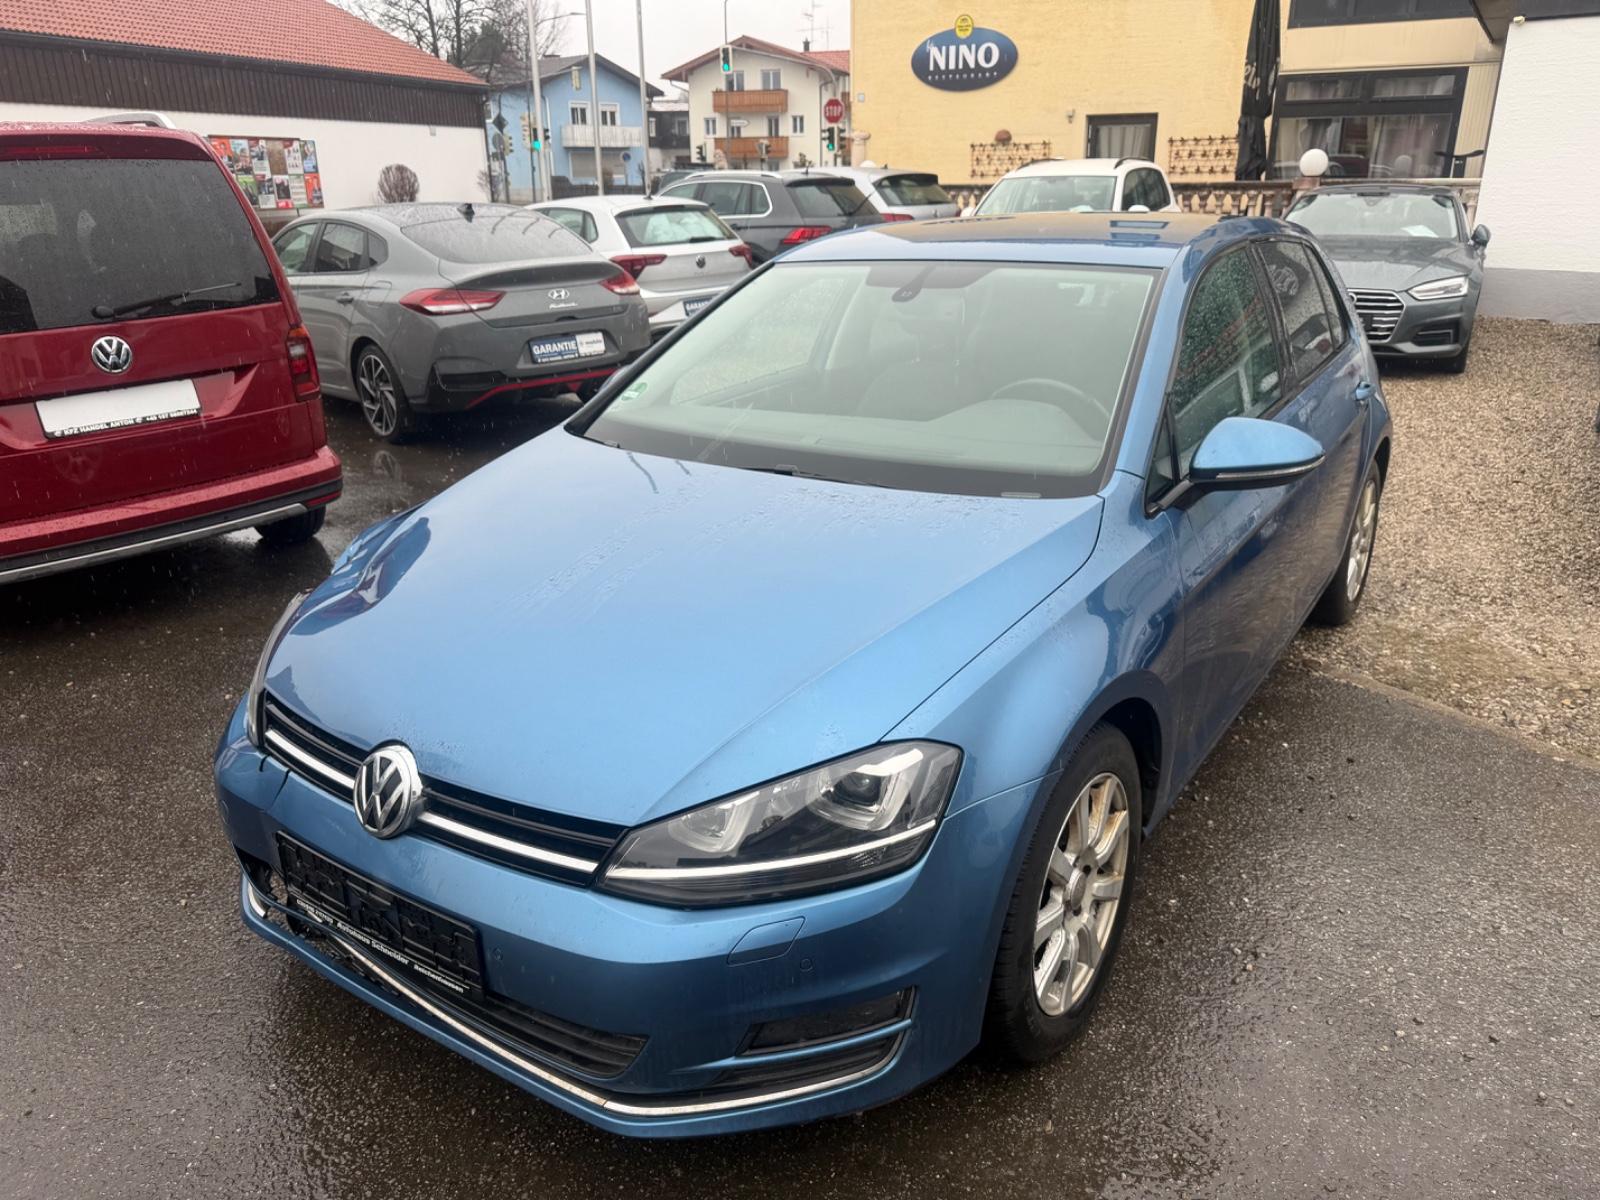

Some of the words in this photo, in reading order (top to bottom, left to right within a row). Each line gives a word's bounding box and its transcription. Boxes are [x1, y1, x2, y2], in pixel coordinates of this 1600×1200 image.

[929, 42, 1000, 71] NINO
[825, 105, 842, 118] STOP
[532, 340, 578, 355] GARANTIE
[80, 422, 108, 433] HANDEL
[337, 922, 371, 945] Autohaus
[371, 940, 409, 965] Schneider
